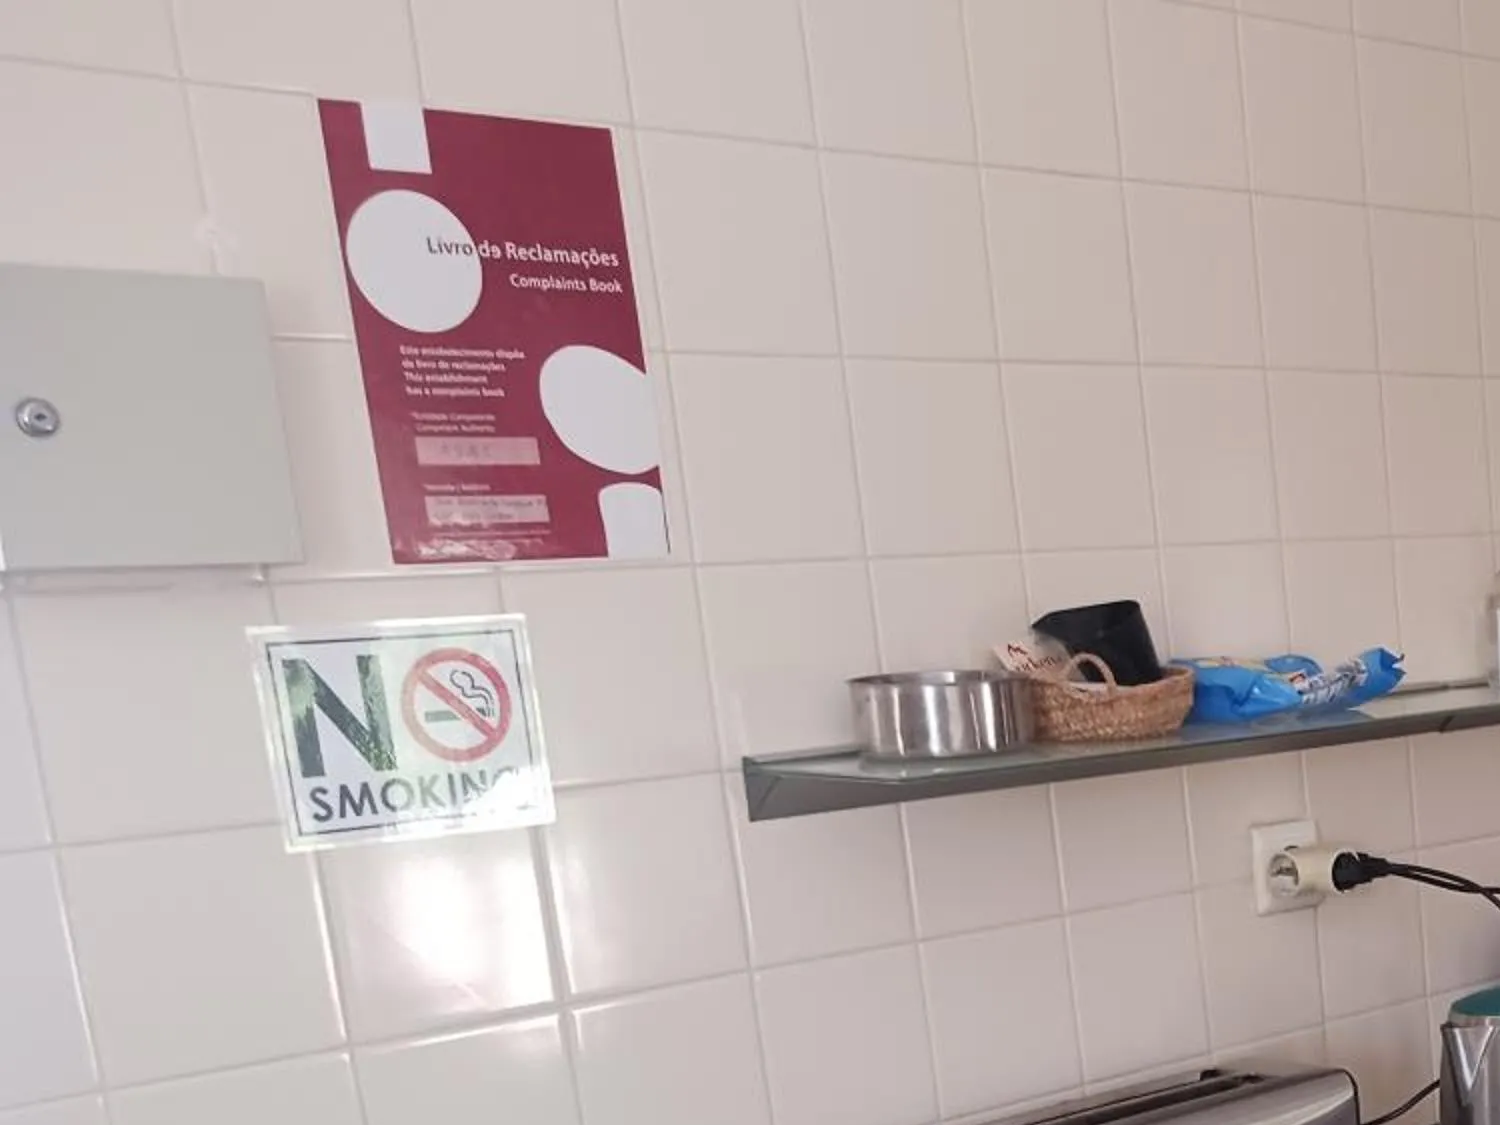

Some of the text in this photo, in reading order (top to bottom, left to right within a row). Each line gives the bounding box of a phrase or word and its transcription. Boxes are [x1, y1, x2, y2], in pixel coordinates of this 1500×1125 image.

[427, 235, 620, 270] Livro de Reclamações
[509, 273, 623, 294] Complaints Book
